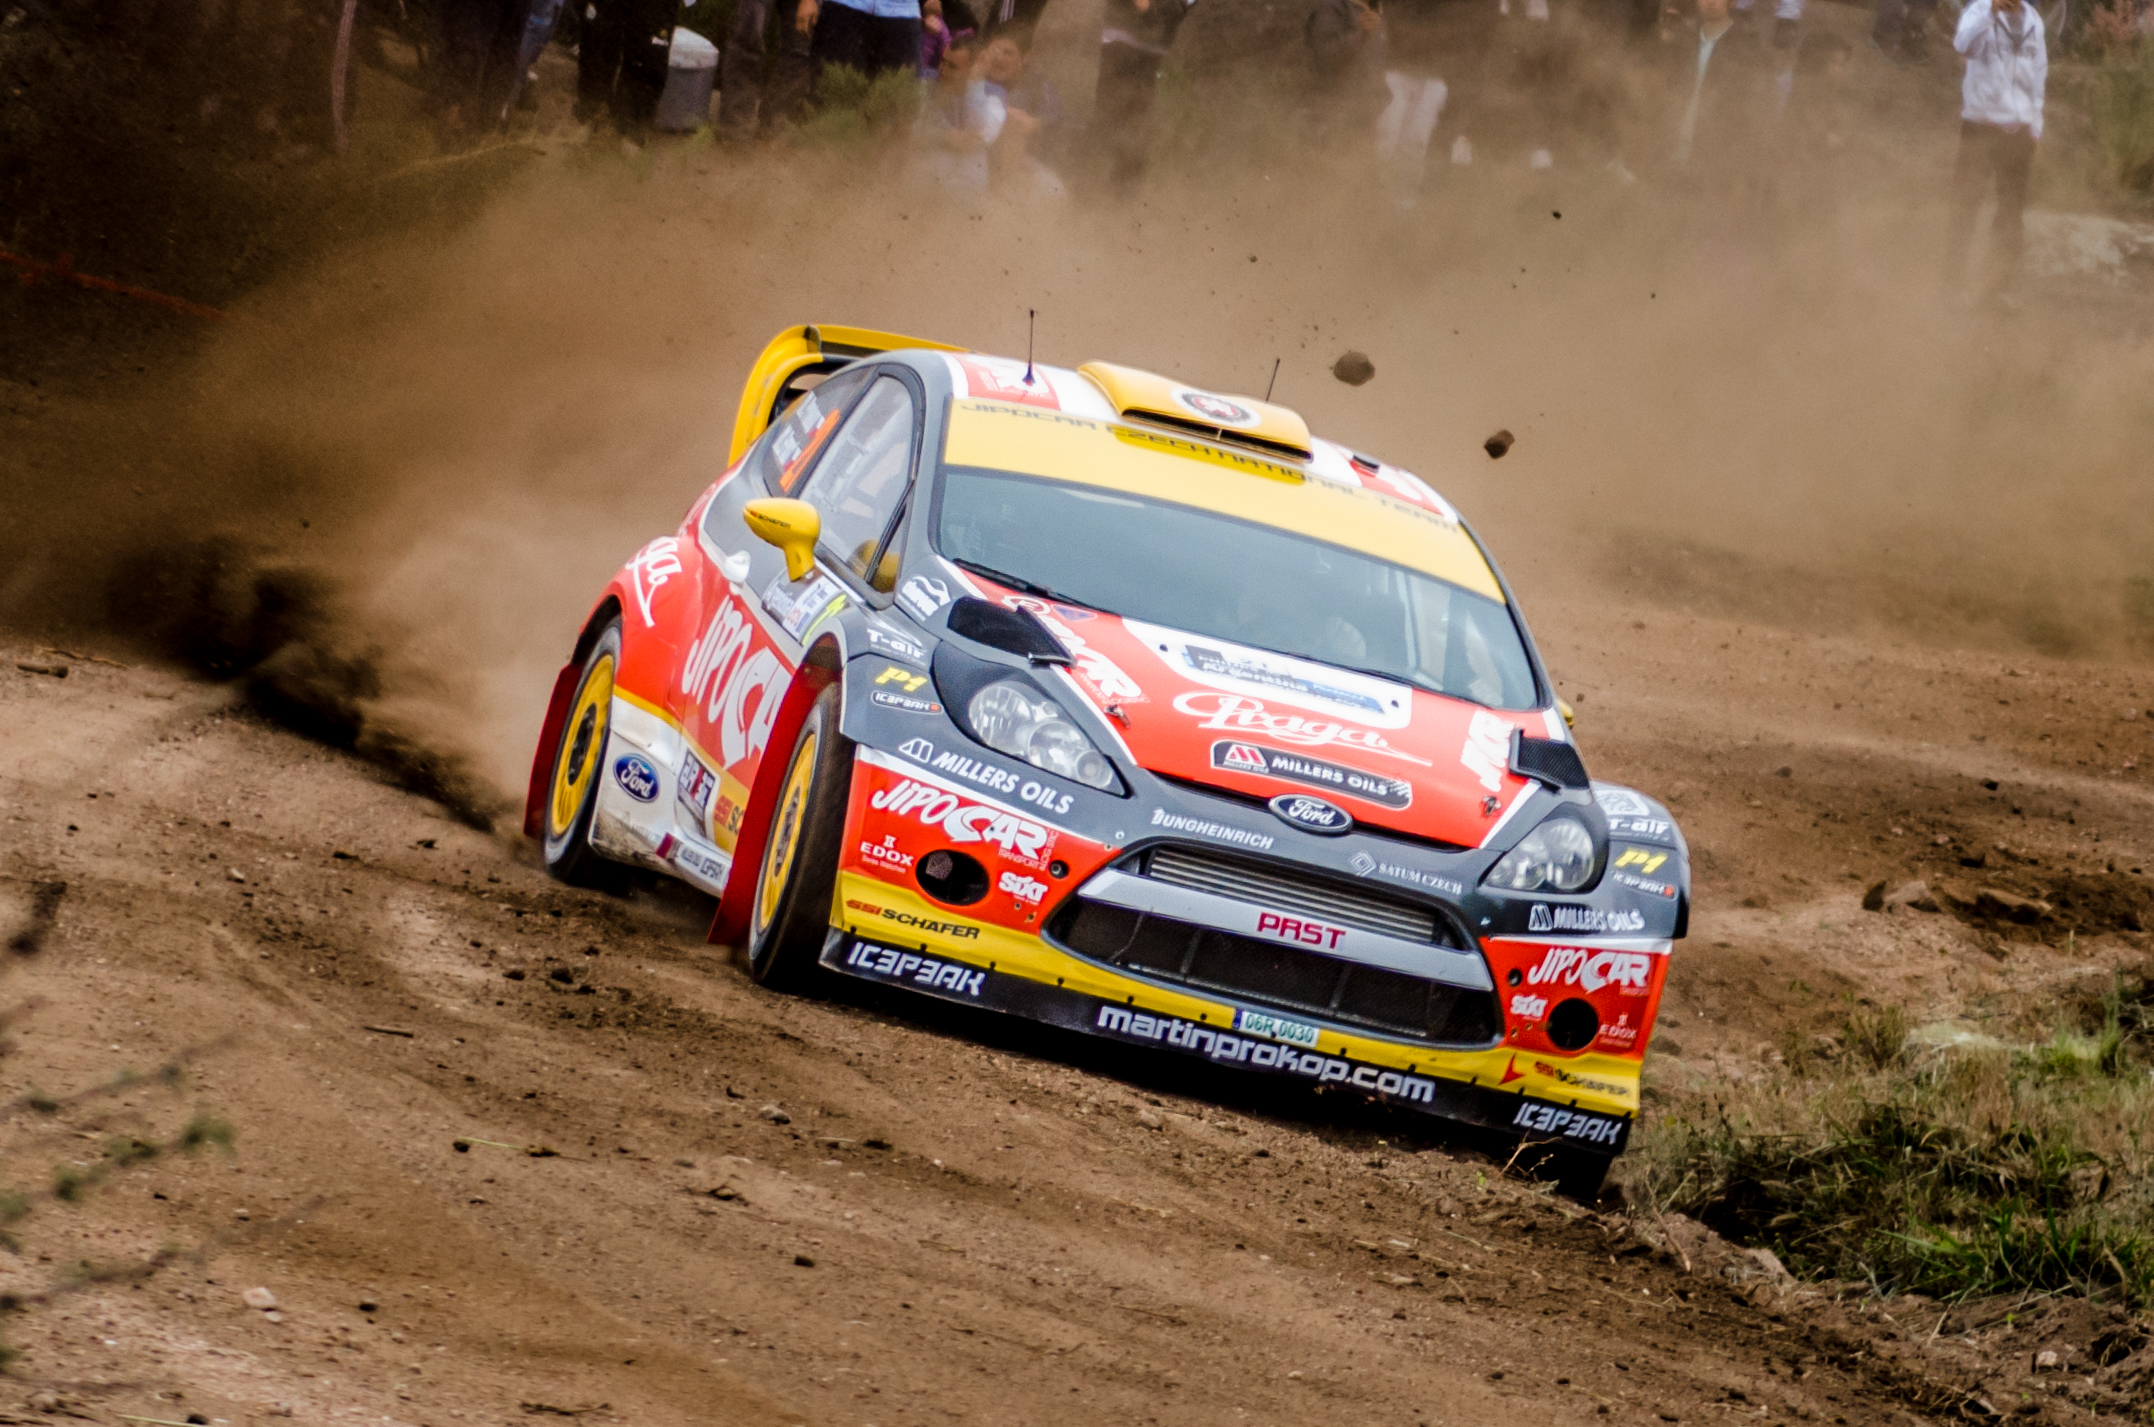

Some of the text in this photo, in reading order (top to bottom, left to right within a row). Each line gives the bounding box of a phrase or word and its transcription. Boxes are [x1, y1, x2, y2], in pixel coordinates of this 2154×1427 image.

[1173, 691, 1412, 756] Praga
[621, 759, 655, 798] Ford
[931, 751, 1075, 815] MILLERS OILS
[1271, 754, 1388, 797] MILLERS OILS
[1150, 806, 1275, 850] JUNGHEINRICH
[1287, 798, 1337, 826] Ford
[860, 841, 914, 867] EDOX
[1378, 861, 1463, 896] SATUM CZECH
[1554, 905, 1646, 932] MILLERS OILS
[1097, 1004, 1436, 1103] martinprokop.com
